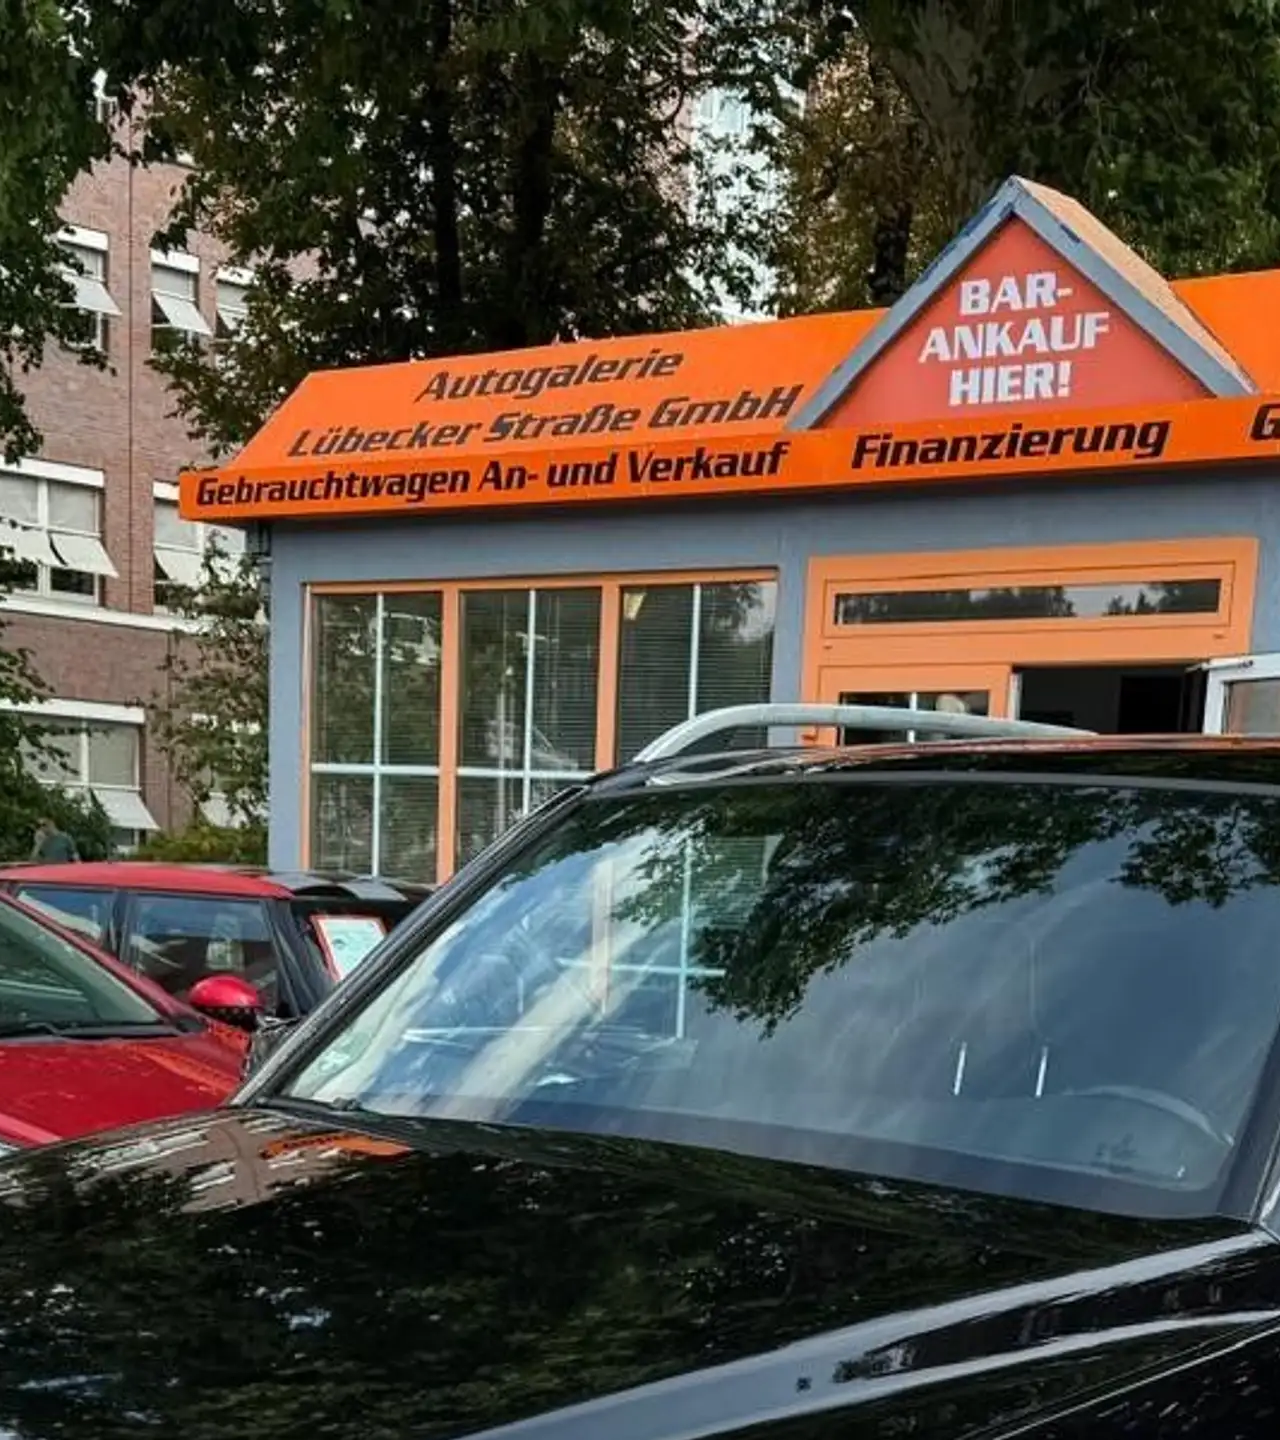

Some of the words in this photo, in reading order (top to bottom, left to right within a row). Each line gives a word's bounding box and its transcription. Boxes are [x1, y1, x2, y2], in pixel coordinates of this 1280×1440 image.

[959, 271, 1073, 317] BAR-
[919, 311, 1111, 363] ANKAUF
[414, 348, 684, 404] Autogalerie
[947, 361, 1071, 406] HIER!
[286, 418, 486, 458] Lübecker
[482, 401, 641, 443] Straße
[648, 384, 804, 429] GmbH
[851, 419, 1171, 469] Finanzierung
[197, 461, 470, 506] Gebrauchtwagen
[478, 459, 538, 491] An-
[546, 446, 616, 487] und
[626, 441, 791, 482] Verkauf
